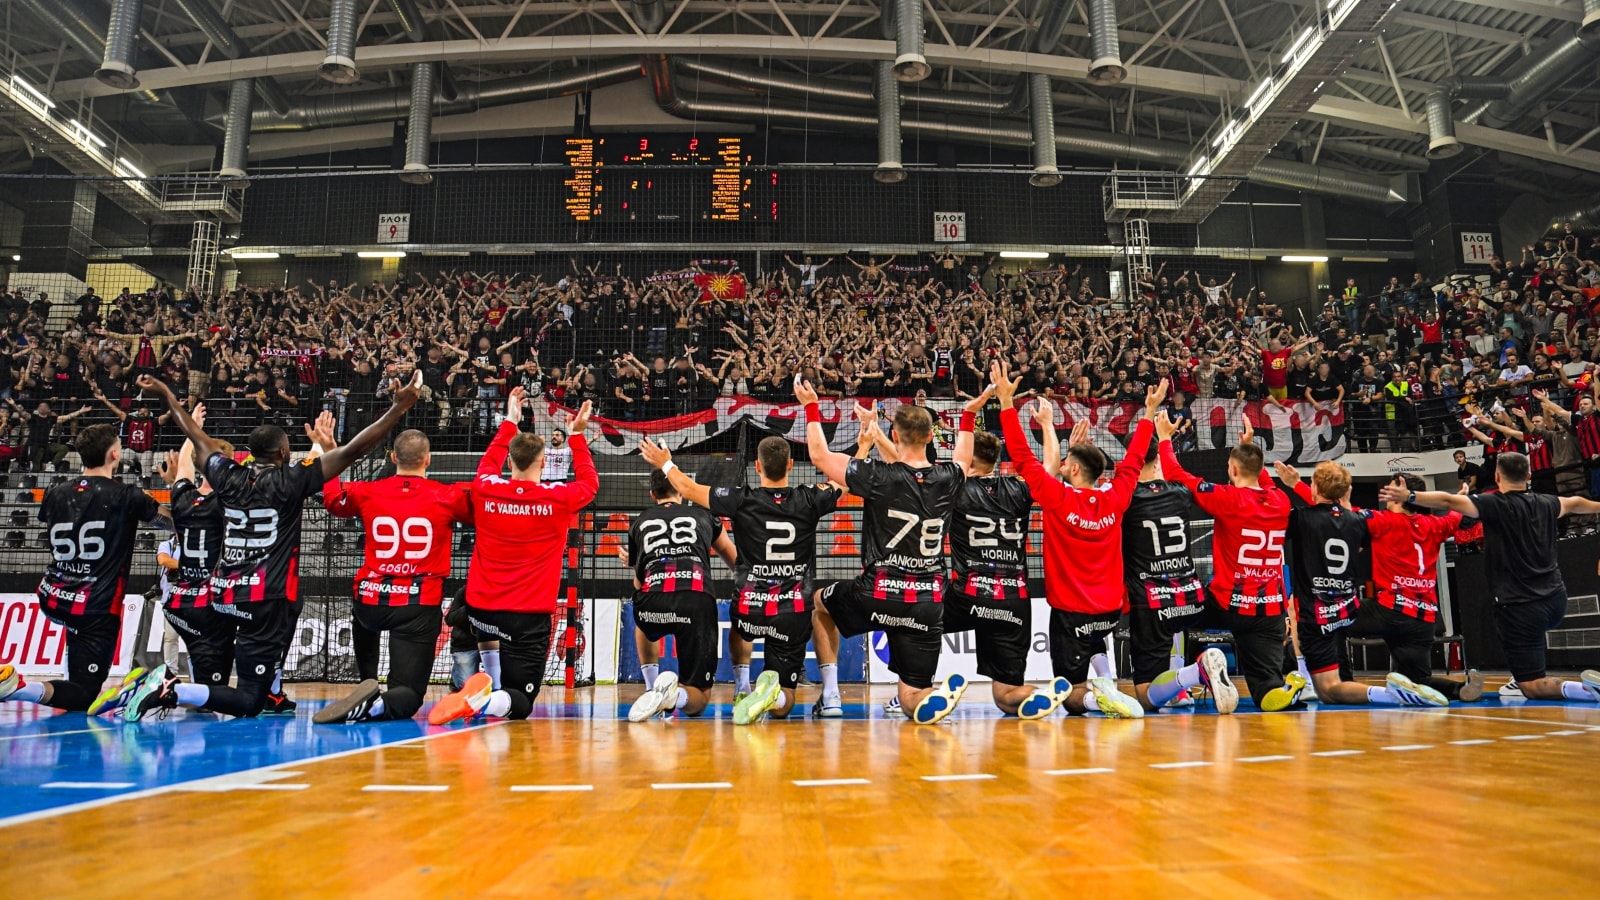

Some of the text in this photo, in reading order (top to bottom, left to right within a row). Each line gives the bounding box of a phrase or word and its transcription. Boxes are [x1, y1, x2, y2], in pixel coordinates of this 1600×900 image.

[640, 139, 647, 150] 3
[690, 139, 698, 150] 2
[632, 181, 638, 189] 2
[390, 225, 397, 238] 9
[943, 223, 957, 238] 10
[1471, 245, 1484, 259] 11
[485, 501, 553, 516] HC VARDAR 1961
[224, 508, 279, 547] 23
[1066, 512, 1079, 525] HC
[1100, 512, 1116, 528] 1961
[372, 516, 433, 559] 99
[640, 516, 698, 554] 28
[885, 509, 945, 557] 78
[965, 513, 1024, 548] 24
[1142, 516, 1187, 556] 13
[50, 521, 106, 561] 66
[183, 528, 208, 568] 4
[765, 521, 796, 560] 2
[1237, 528, 1287, 566] 25
[981, 549, 1018, 560] HORIHA
[1324, 537, 1350, 574] 9
[1413, 543, 1425, 576] 1
[378, 563, 418, 574] GOGOV
[1150, 556, 1190, 572] MITROVIC
[645, 570, 692, 586] SPARKASSE
[878, 580, 932, 592] SPARKASSE
[360, 581, 408, 594] SPARKASSE
[938, 631, 977, 654] NL
